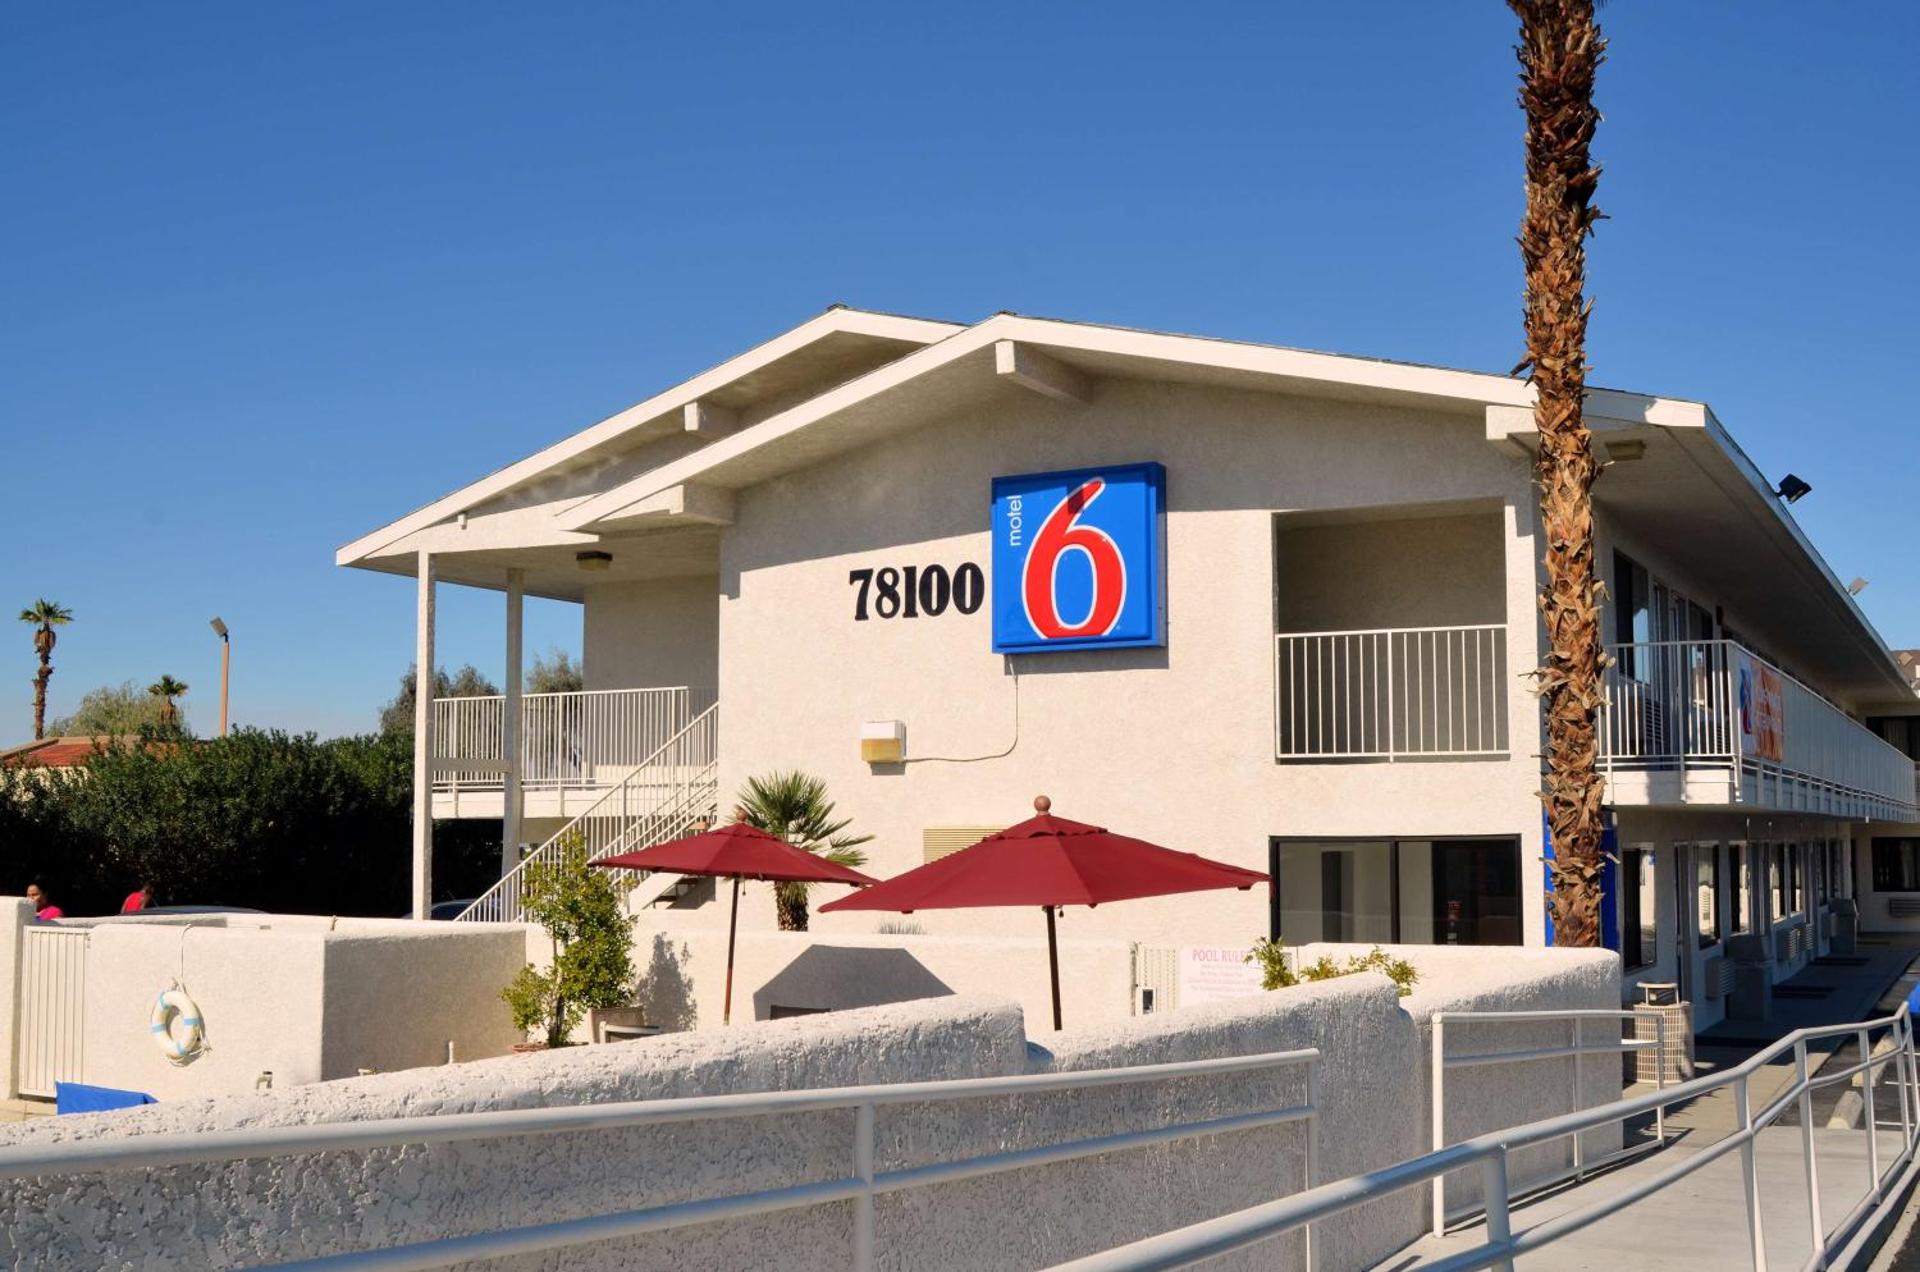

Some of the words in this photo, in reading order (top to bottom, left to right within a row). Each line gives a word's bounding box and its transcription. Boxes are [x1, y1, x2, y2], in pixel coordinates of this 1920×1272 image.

[1006, 495, 1022, 546] motel
[1022, 477, 1127, 640] 6
[849, 561, 985, 620] 78100
[1192, 949, 1219, 962] POOL
[1222, 950, 1250, 963] RULE
